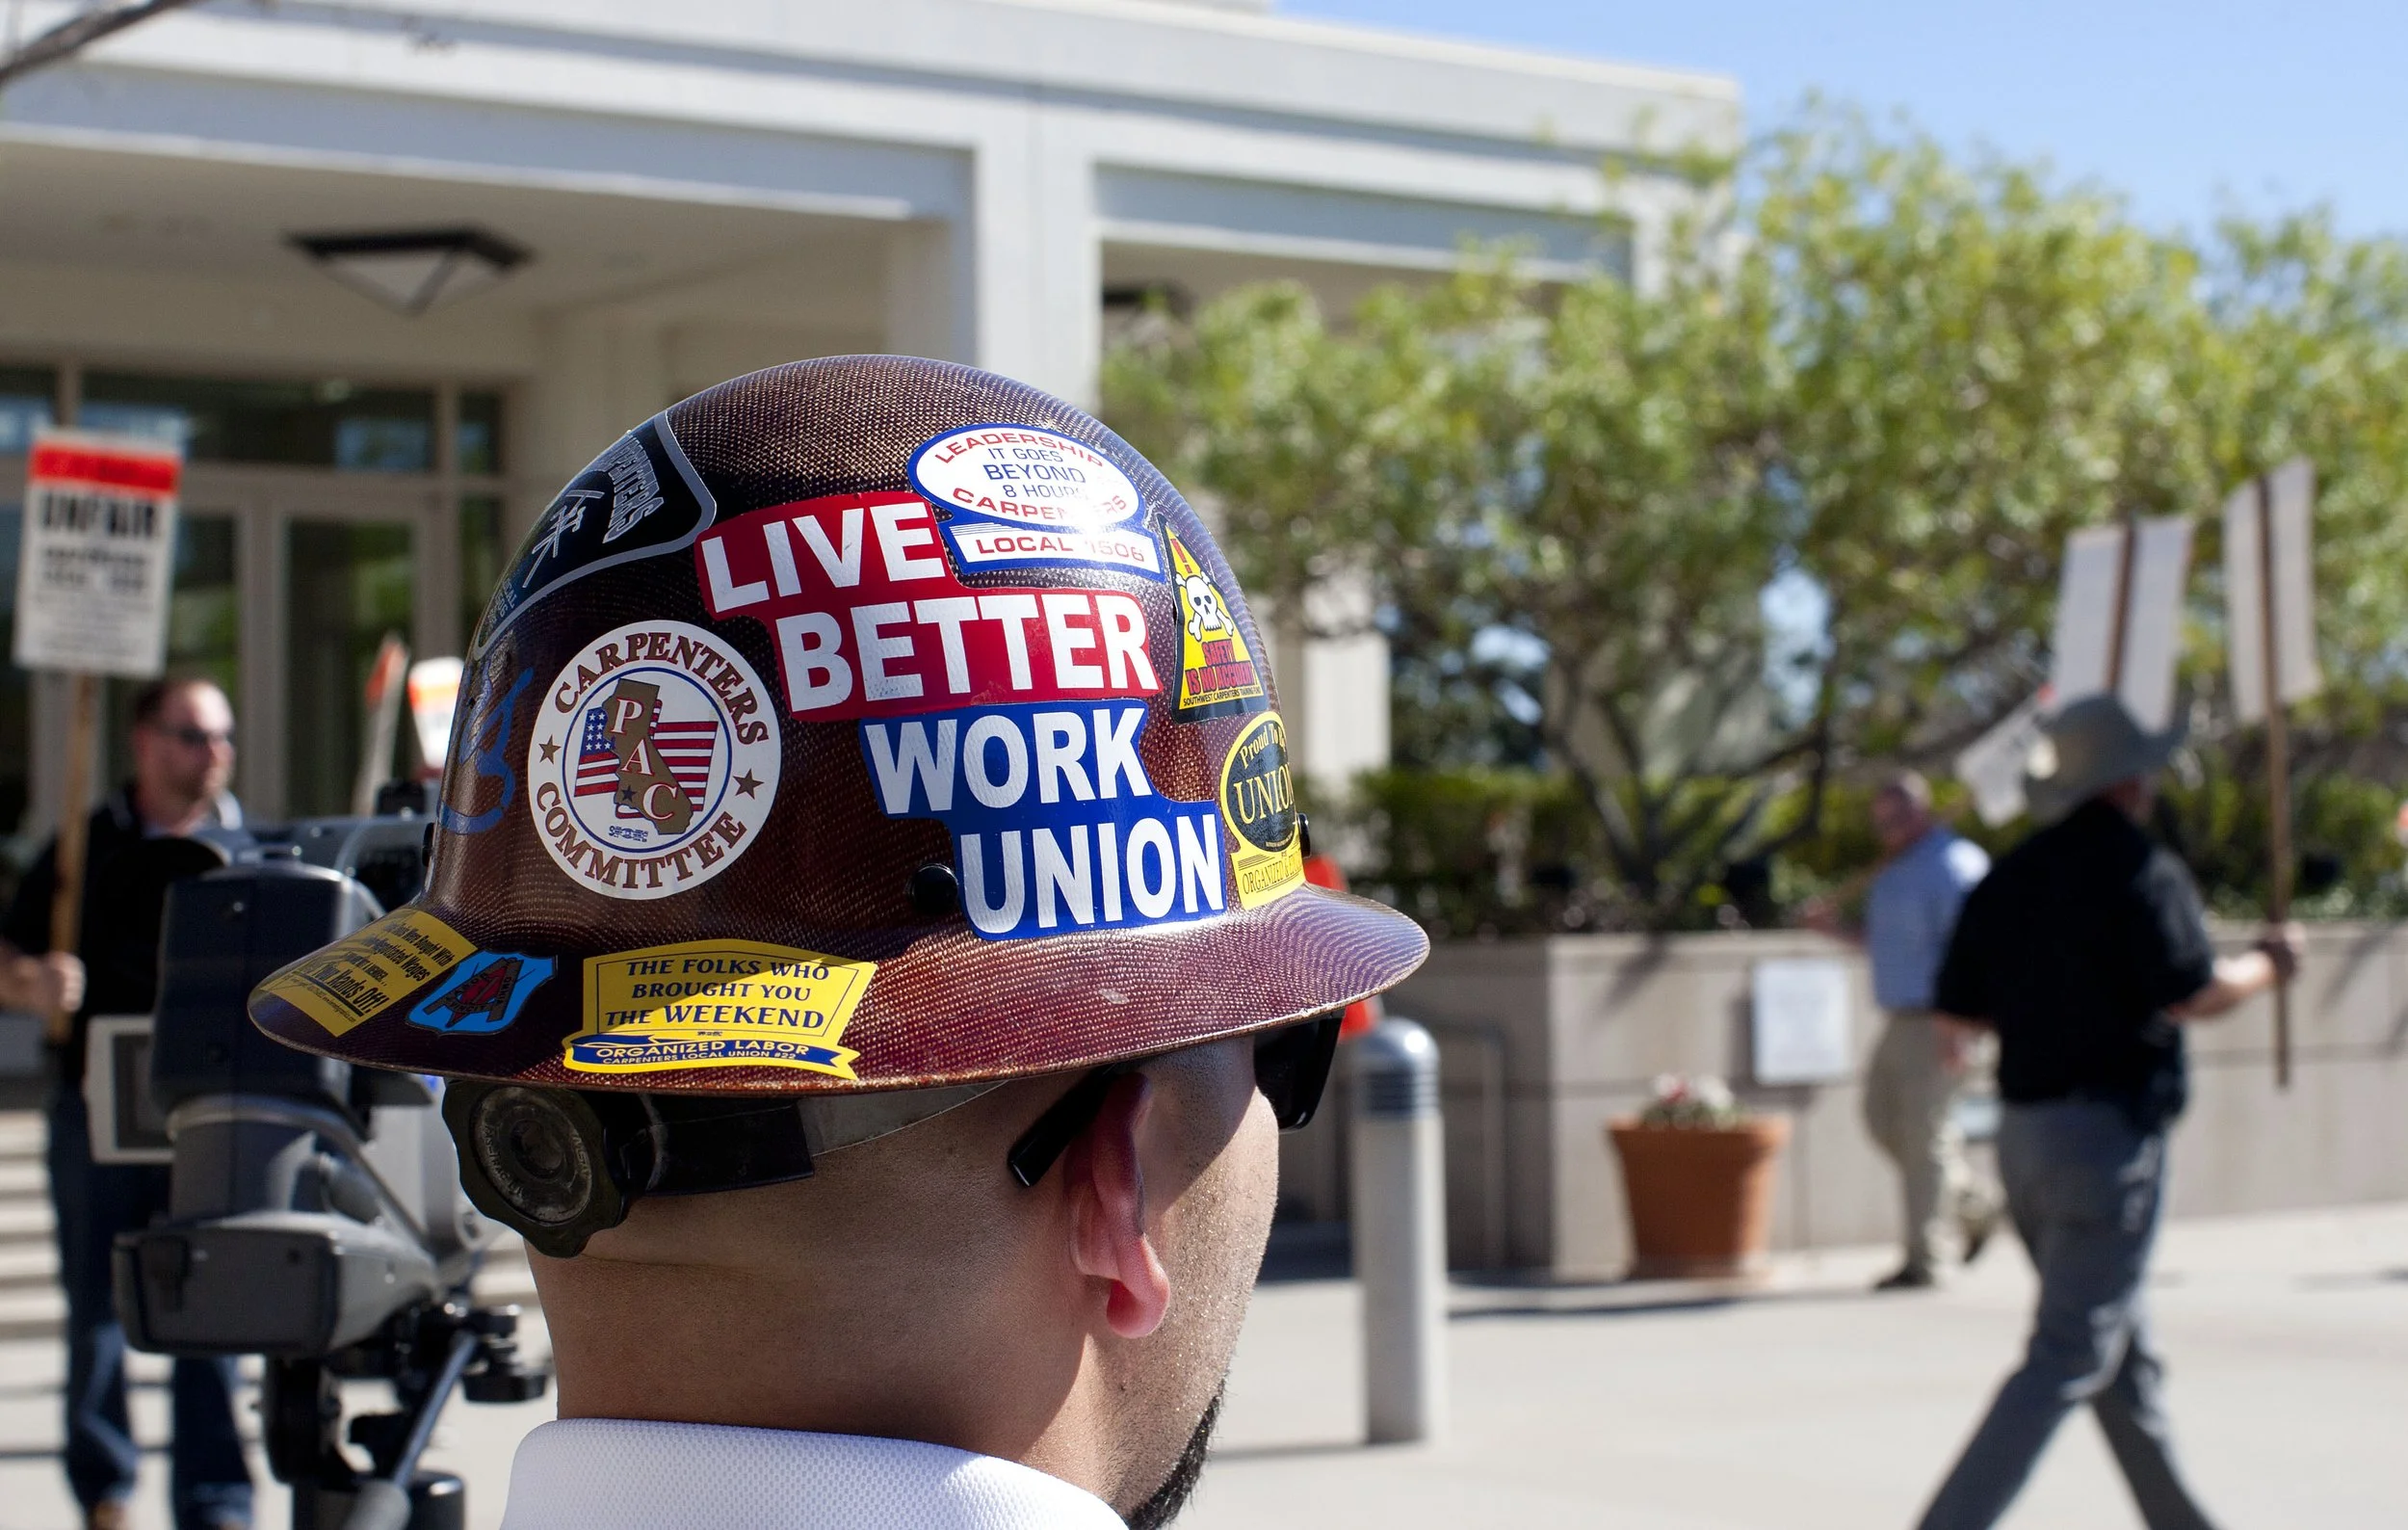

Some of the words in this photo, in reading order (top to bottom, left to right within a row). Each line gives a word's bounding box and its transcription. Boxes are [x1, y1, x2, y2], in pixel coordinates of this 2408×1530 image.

[935, 434, 1103, 467] LEADERSHIP
[988, 448, 1006, 461] IT
[1013, 448, 1063, 462] GOES
[983, 464, 1086, 484] BEYOND
[954, 488, 1127, 520] CARPENRS
[1005, 485, 1017, 498] 8
[1025, 485, 1087, 500] HOUR
[701, 502, 946, 613] LIVE
[976, 537, 1074, 554] LOCAL
[775, 593, 1159, 712] BETTER
[1201, 639, 1237, 666] SAFETY
[555, 632, 769, 745] CARPENTERS
[1185, 669, 1201, 696] IS
[1198, 667, 1217, 693] NO
[1183, 693, 1213, 706] SOUTHWEST
[1213, 689, 1241, 700] CARPENTERS
[1240, 725, 1269, 770] Proud
[1268, 724, 1278, 744] To
[866, 708, 1152, 814] WORK
[537, 782, 747, 888] COMMITTEE
[960, 814, 1224, 934] UNION
[1243, 860, 1283, 895] ORGANIZED
[401, 956, 431, 981] Wages
[432, 947, 455, 966] With
[627, 959, 674, 976] THE
[682, 959, 761, 975] FOLKS
[771, 962, 829, 980] WHO
[327, 969, 367, 998] Hands
[353, 987, 390, 1014] Off!
[632, 982, 755, 999] BROUGHT
[760, 984, 811, 1001] YOU
[605, 1010, 653, 1026] THE
[663, 1005, 824, 1028] WEEKEND
[596, 1041, 731, 1058] ORGANIZED
[733, 1040, 809, 1056] LABOR
[602, 1053, 678, 1065] CARPENTERS
[682, 1051, 722, 1060] LOCAL
[773, 1051, 797, 1060] #22
